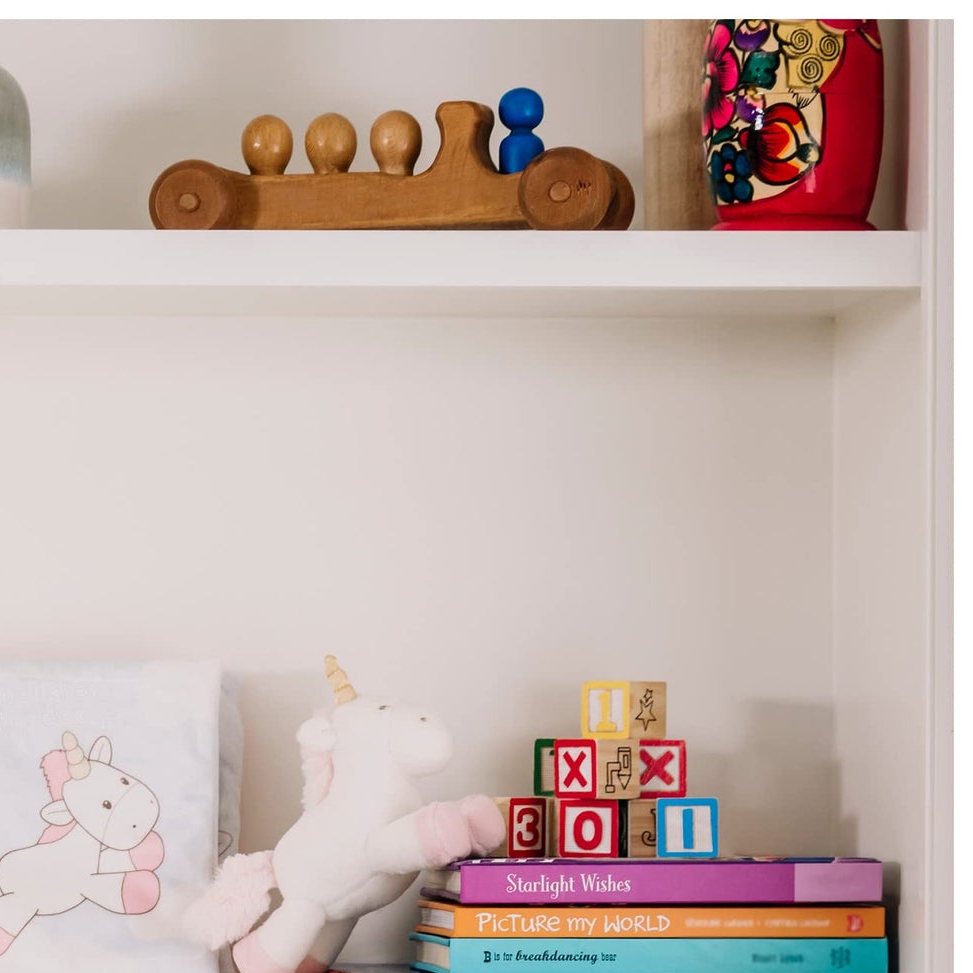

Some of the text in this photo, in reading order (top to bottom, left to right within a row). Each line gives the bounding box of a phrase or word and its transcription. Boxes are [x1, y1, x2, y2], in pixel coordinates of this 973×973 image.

[595, 690, 617, 731] 1
[562, 751, 588, 788] X
[640, 749, 675, 786] X
[517, 807, 540, 847] 3
[506, 873, 631, 899] Starlight Wishes
[567, 916, 597, 935] my
[483, 950, 617, 965] B is for breakdancing bear
